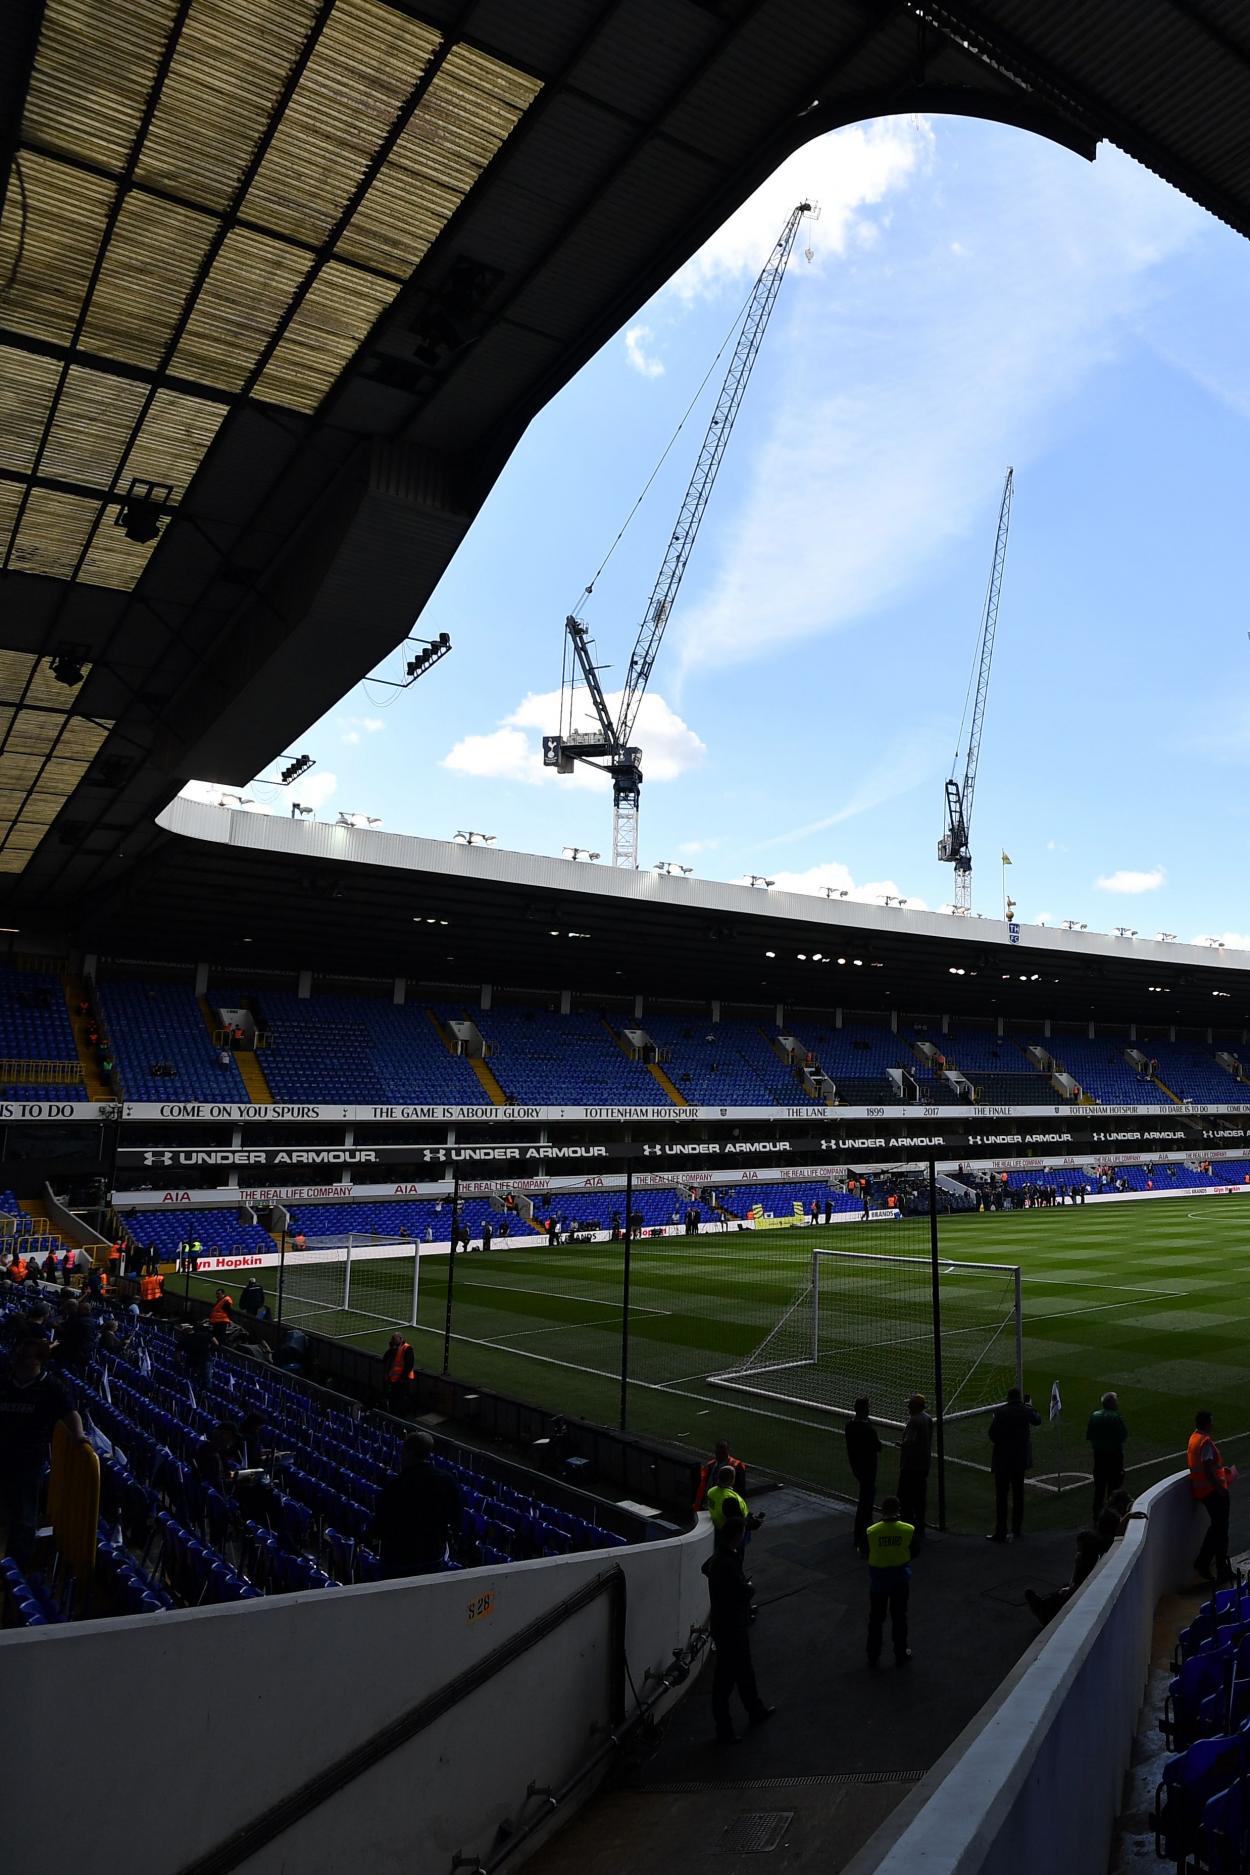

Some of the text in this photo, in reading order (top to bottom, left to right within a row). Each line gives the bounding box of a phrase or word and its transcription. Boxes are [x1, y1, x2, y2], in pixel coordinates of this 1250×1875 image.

[18, 1104, 42, 1118] TO
[48, 1104, 74, 1118] DO
[160, 1104, 320, 1118] COME ON YOU SPURS
[372, 1107, 542, 1118] THE GAME IS ABOUT GLORY
[584, 1108, 699, 1118] TOTTENHAM HOTSPUR
[786, 1108, 828, 1117] THE LANE
[866, 1108, 884, 1116] 1899
[924, 1107, 940, 1116] 2017
[974, 1107, 1012, 1116] THE FINALE
[1070, 1106, 1138, 1114] TOTTENHAM HOTSPUR
[1106, 1132, 1142, 1140] UNDER
[1214, 1130, 1244, 1138] UNDER
[839, 1139, 886, 1148] UNDER
[984, 1135, 1022, 1144] UNDER
[451, 1148, 520, 1160] UNDER
[666, 1144, 722, 1154] UNDER
[180, 1152, 266, 1164] UNDER
[742, 1172, 758, 1180] AIA
[780, 1170, 790, 1178] THE
[791, 1170, 806, 1178] REAL
[820, 1168, 847, 1176] COMPANY
[584, 1178, 604, 1187] AIA
[636, 1174, 712, 1184] THE REAL LIFE COMPANY
[394, 1184, 418, 1194] AIA
[458, 1180, 550, 1192] THE REAL LIFE COMPANY
[162, 1192, 192, 1202] AIA
[240, 1188, 352, 1200] THE REAL LIFE COMPANY
[871, 1210, 894, 1218] BRANDS
[216, 1256, 262, 1268] Hopkin
